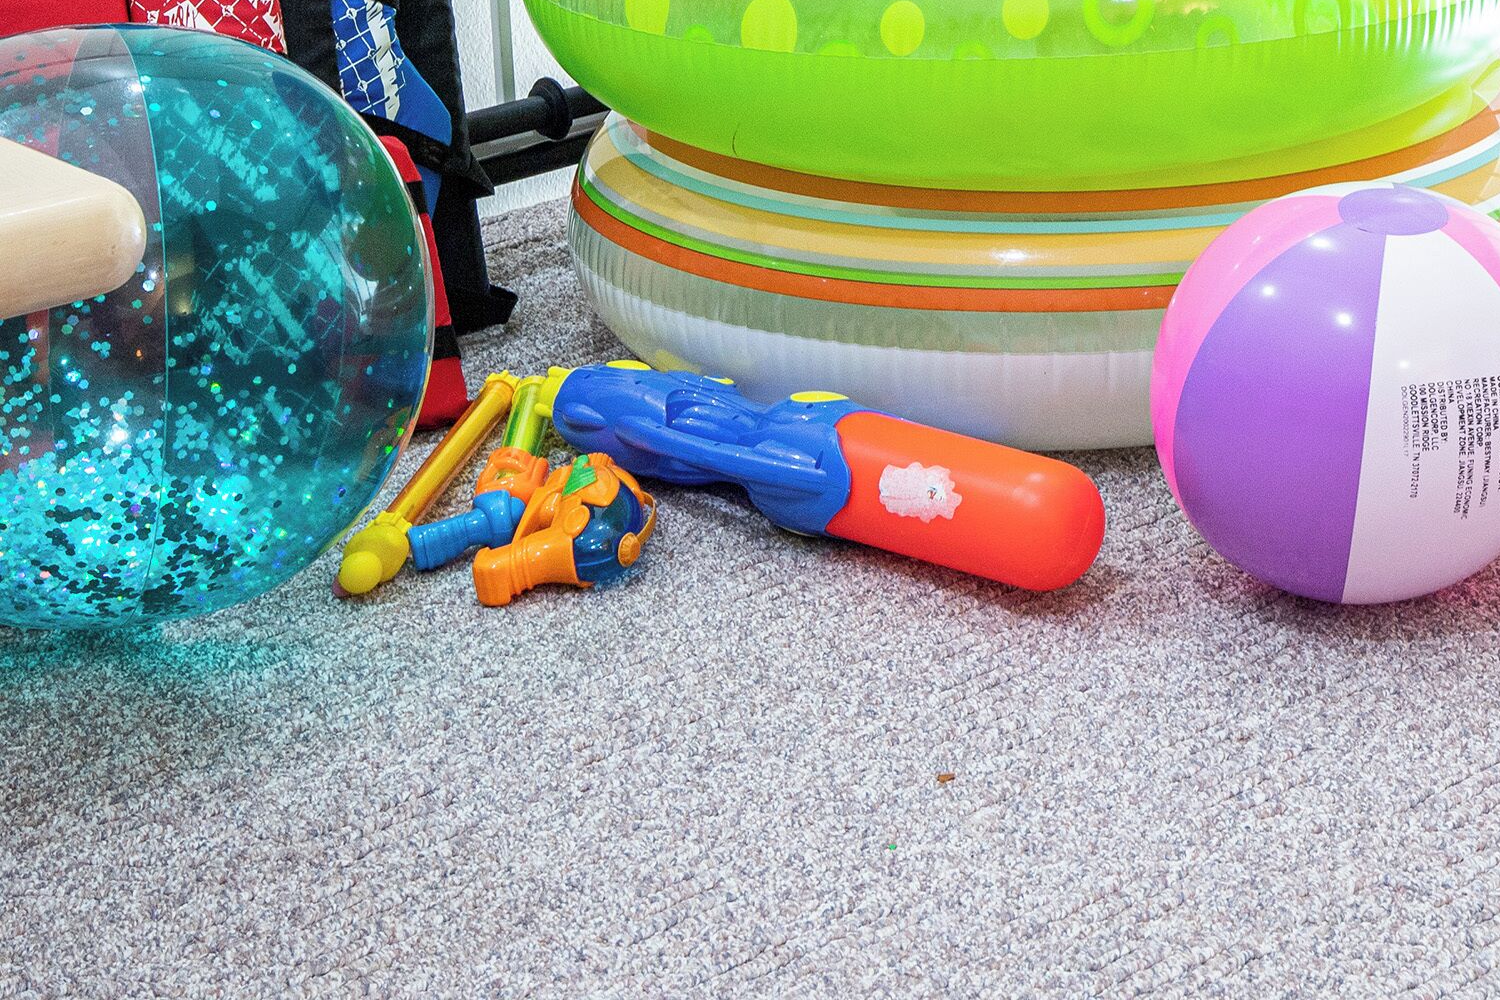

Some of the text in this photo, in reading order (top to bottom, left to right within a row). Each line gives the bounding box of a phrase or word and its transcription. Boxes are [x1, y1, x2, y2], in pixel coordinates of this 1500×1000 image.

[1437, 382, 1448, 430] DISTRIBUTED
[1446, 381, 1454, 404] CHINA
[1455, 380, 1466, 434] DEVELOPMENT
[1473, 378, 1482, 424] RECREATION
[1421, 397, 1429, 427] MISSION
[1422, 429, 1430, 452] RIDGE
[1466, 460, 1474, 484] FUNING
[1461, 486, 1472, 520] ECONOMIC
